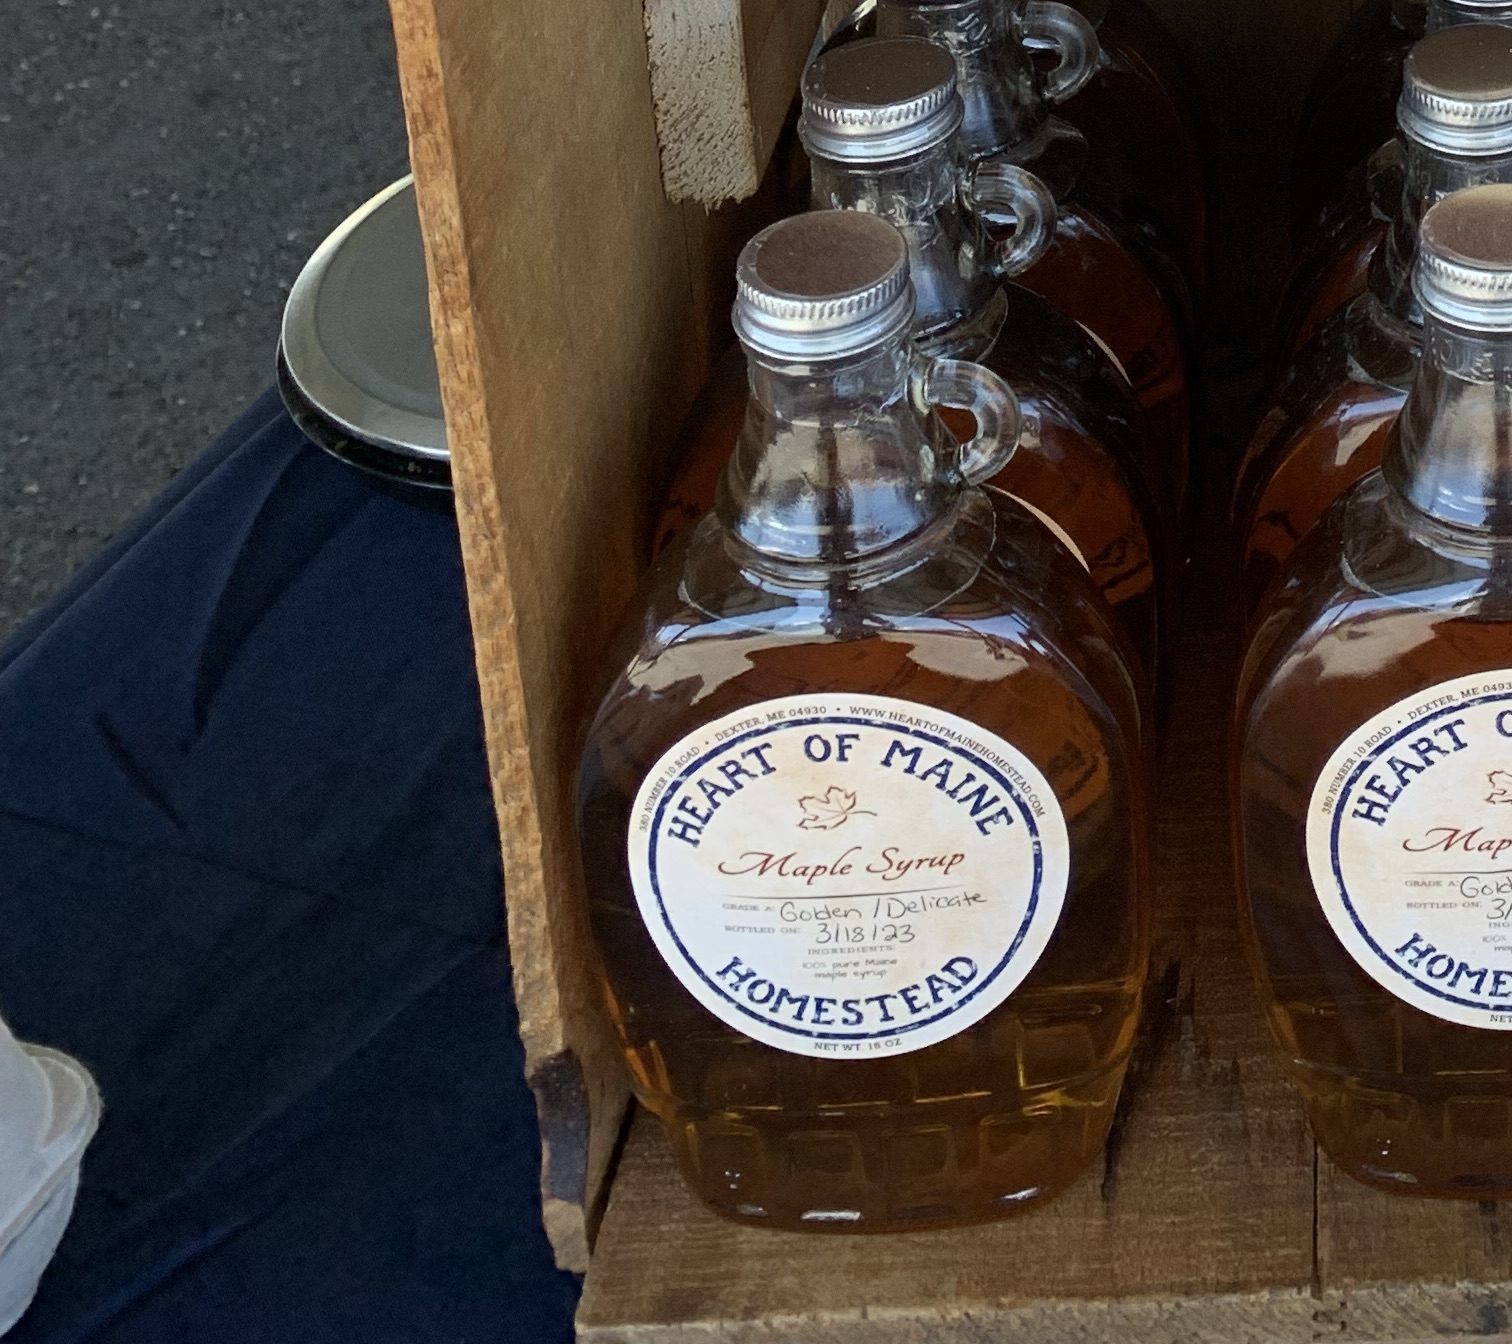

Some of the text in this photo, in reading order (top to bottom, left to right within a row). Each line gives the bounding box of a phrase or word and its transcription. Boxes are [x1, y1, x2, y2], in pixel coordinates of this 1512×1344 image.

[766, 711, 786, 721] ME
[1460, 688, 1479, 698] ME
[667, 734, 1015, 849] HEART OF MAINE
[1352, 719, 1468, 827] HEART
[718, 846, 965, 885] Maple Syrup
[715, 956, 978, 1026] HOMESTEAD
